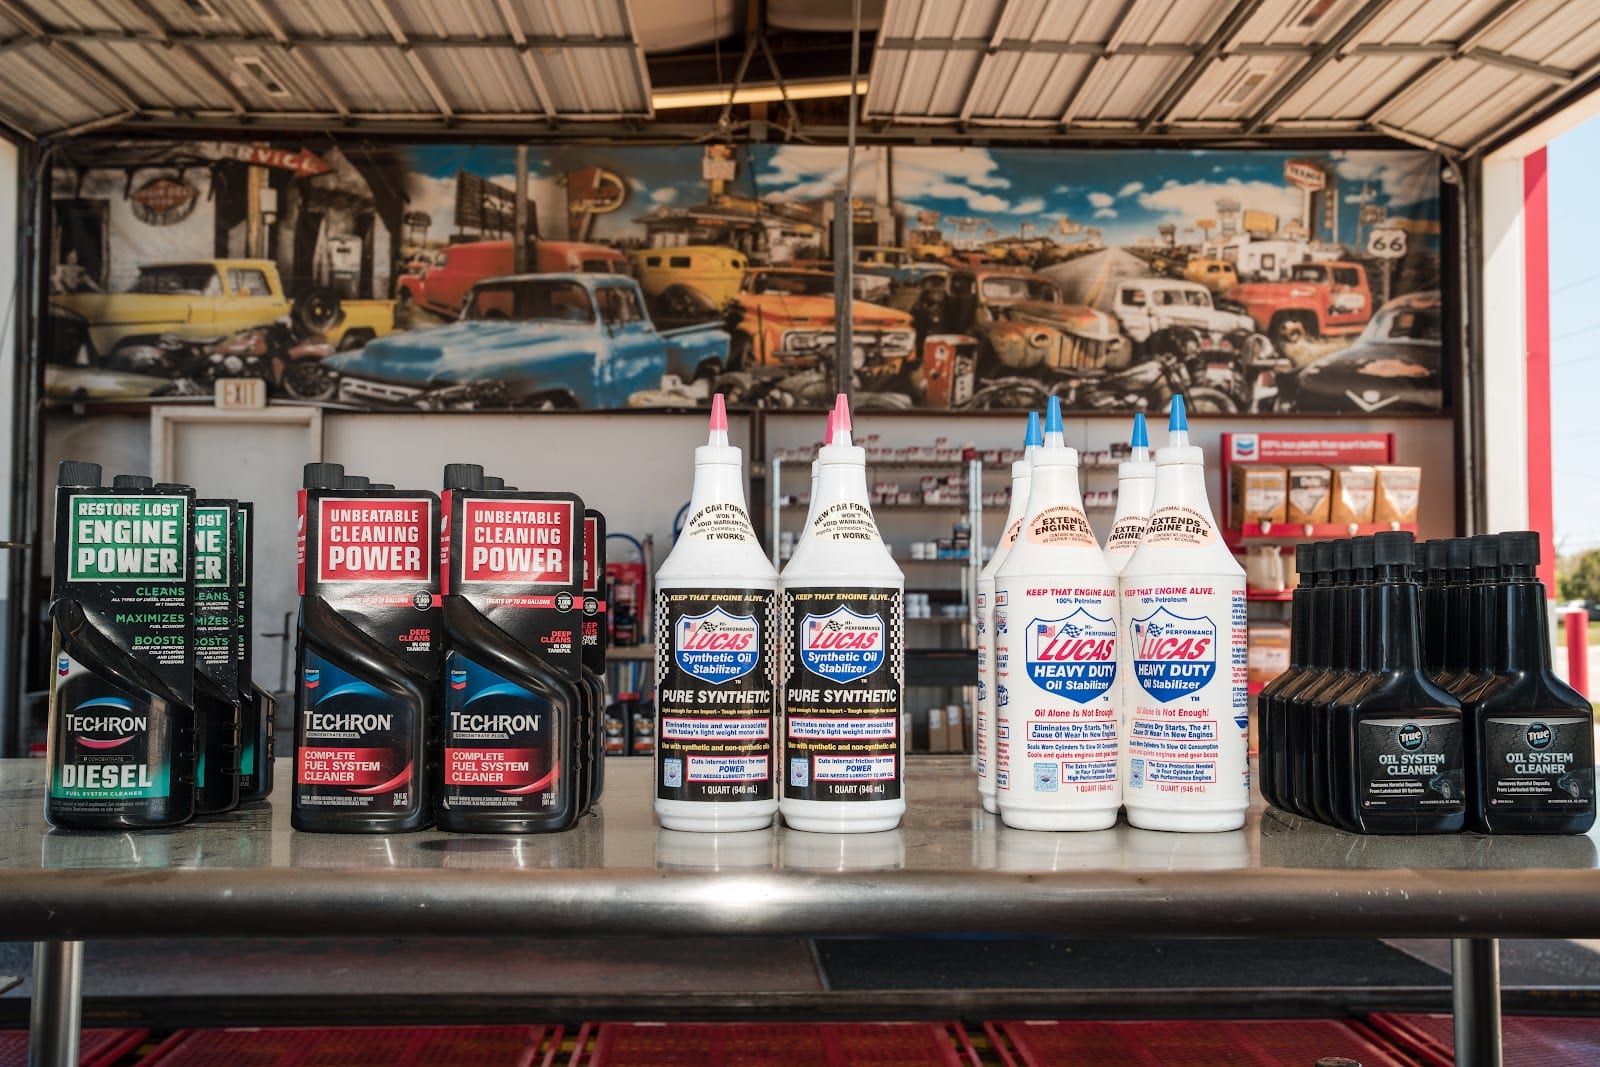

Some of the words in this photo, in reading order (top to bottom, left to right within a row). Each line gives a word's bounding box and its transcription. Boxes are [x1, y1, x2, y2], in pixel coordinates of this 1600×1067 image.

[1372, 236, 1403, 252] 66
[223, 380, 257, 406] EXIT
[78, 503, 140, 516] RESTORE
[144, 503, 179, 516] LOST
[330, 509, 419, 523] UNBEATABLE
[474, 510, 561, 525] UNBEATABLE
[1152, 516, 1201, 528] EXTENDS
[78, 520, 178, 544] ENGINE
[330, 525, 419, 543] CLEANING
[474, 526, 561, 545] CLEANING
[842, 532, 872, 541] WORKS!
[1145, 524, 1182, 535] ENGINE
[1185, 524, 1209, 537] LIFE
[716, 533, 746, 541] WORKS!
[77, 547, 178, 573] POWER
[328, 545, 421, 571] POWER
[472, 546, 563, 573] POWER
[135, 587, 185, 596] CLEANS
[1026, 588, 1048, 596] KEEP
[1050, 588, 1073, 596] THAT
[1074, 588, 1102, 596] ENGINE
[1137, 588, 1153, 596] THAT
[1154, 587, 1188, 595] ENGINE
[1189, 587, 1215, 595] ALIVE.
[1074, 597, 1102, 605] Petroleum
[115, 614, 185, 623] MAXIMIZES
[134, 636, 184, 645] BOOSTS
[683, 633, 753, 650] LUCAS
[808, 632, 879, 649] LUCAS
[1037, 639, 1115, 661] LUCAS
[1138, 637, 1211, 660] LUCAS
[682, 652, 734, 665] Synthetic
[737, 652, 752, 663] Oil
[807, 652, 860, 664] Synthetic
[863, 652, 878, 662] Oil
[693, 664, 742, 674] Stabilizer
[818, 663, 867, 673] Stabilizer
[1034, 665, 1085, 678] HEAVY
[1088, 665, 1115, 678] DUTY
[1138, 663, 1166, 677] HEAVY
[1169, 664, 1211, 677] DUTY
[1045, 680, 1062, 690] Oil
[1066, 680, 1109, 690] Stabilizer
[1143, 679, 1152, 689] Oil
[1152, 679, 1200, 689] Stabilizer
[662, 689, 694, 703] PURE
[697, 690, 771, 704] SYNTHETIC
[788, 688, 821, 703] PURE
[823, 688, 897, 703] SYNTHETIC
[1034, 709, 1046, 717] Oil
[1047, 709, 1071, 717] Alone
[1072, 709, 1080, 717] Is
[1082, 709, 1094, 717] Not
[1155, 708, 1161, 716] Is
[1162, 707, 1176, 717] Not
[1178, 708, 1210, 719] Enough!
[65, 713, 147, 735] TECHRON
[303, 710, 391, 734] TECHRON
[450, 711, 539, 735] TECHRON
[1134, 721, 1154, 730] Eliminates
[1154, 723, 1164, 731] Dry
[1149, 729, 1162, 737] Wear
[1188, 731, 1214, 739] Engines
[1400, 731, 1422, 743] True
[1527, 729, 1550, 742] True
[304, 751, 356, 760] COMPLETE
[452, 752, 505, 761] COMPLETE
[1378, 754, 1400, 764] OIL
[1401, 754, 1445, 764] SYSTEM
[1505, 753, 1527, 763] OIL
[1528, 753, 1574, 763] SYSTEM
[304, 761, 330, 770] FUEL
[332, 761, 381, 771] SYSTEM
[452, 762, 478, 771] FUEL
[481, 762, 529, 772] SYSTEM
[718, 765, 745, 773] POWER
[1387, 764, 1439, 776] CLEANER
[1514, 763, 1566, 774] CLEANER
[62, 764, 153, 789] DIESEL
[304, 771, 355, 781] CLEANER
[451, 772, 504, 782] CLEANER
[702, 786, 706, 794] 1
[707, 786, 731, 794] QUART
[732, 786, 746, 795] (946
[747, 785, 758, 794] mL)
[828, 785, 833, 793] 1
[834, 785, 858, 794] QUART
[859, 785, 874, 795] (946
[874, 784, 885, 794] mL)
[1180, 785, 1194, 793] (946
